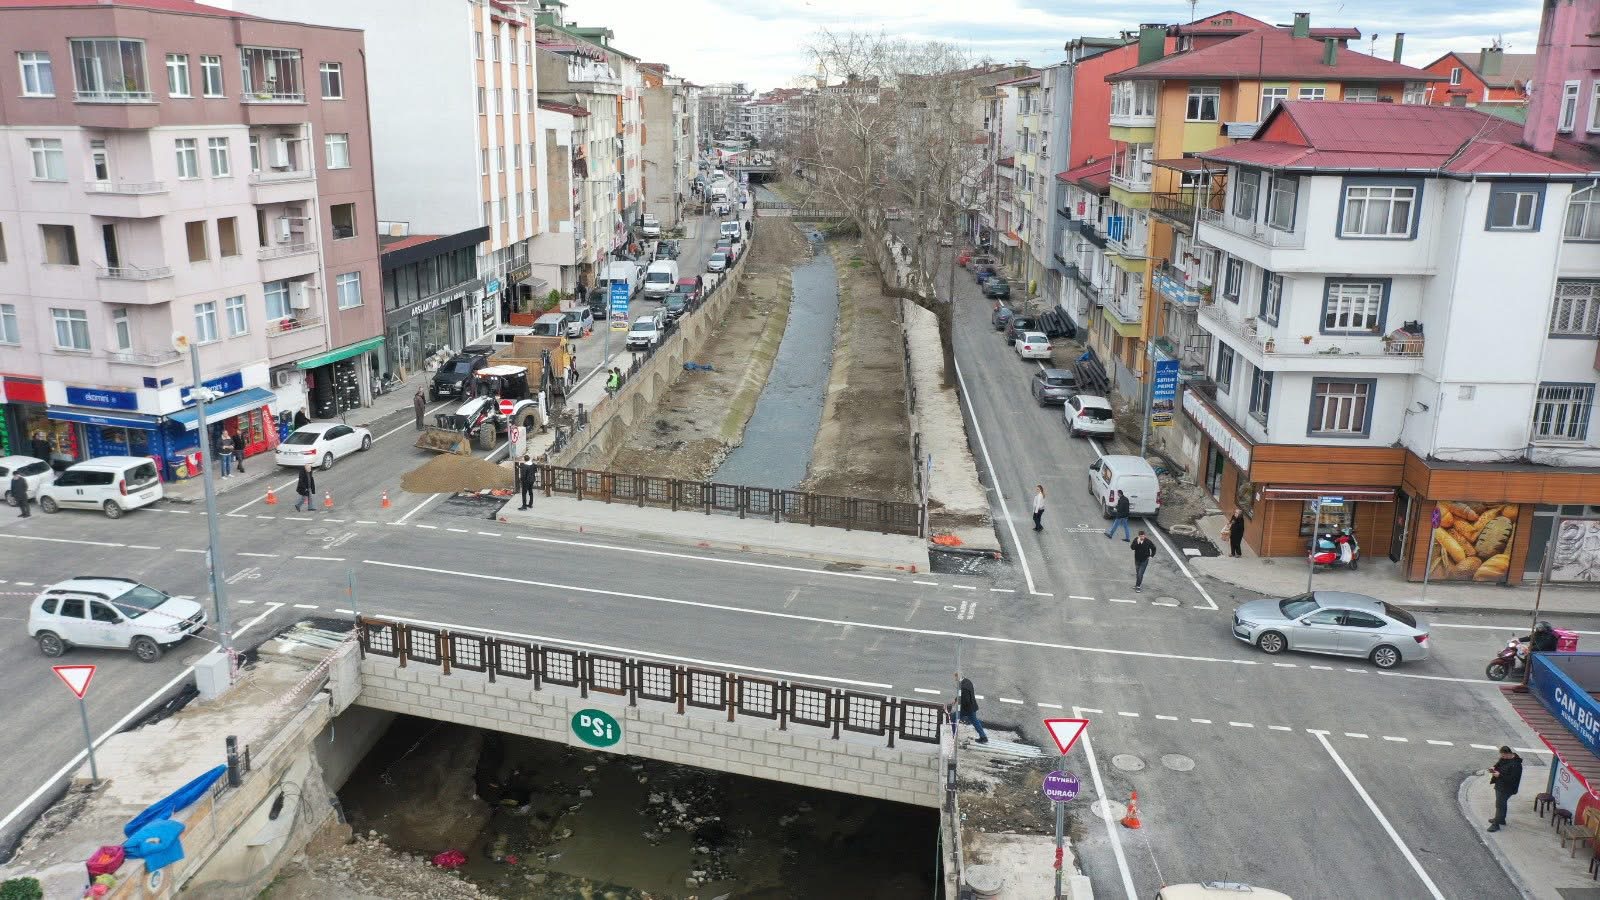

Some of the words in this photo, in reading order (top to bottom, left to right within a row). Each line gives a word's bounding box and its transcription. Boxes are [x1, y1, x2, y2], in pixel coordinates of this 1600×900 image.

[85, 392, 109, 403] ekomini
[1555, 687, 1576, 716] CAN
[1578, 707, 1600, 740] BÜF
[1046, 789, 1075, 798] DURAĞI
